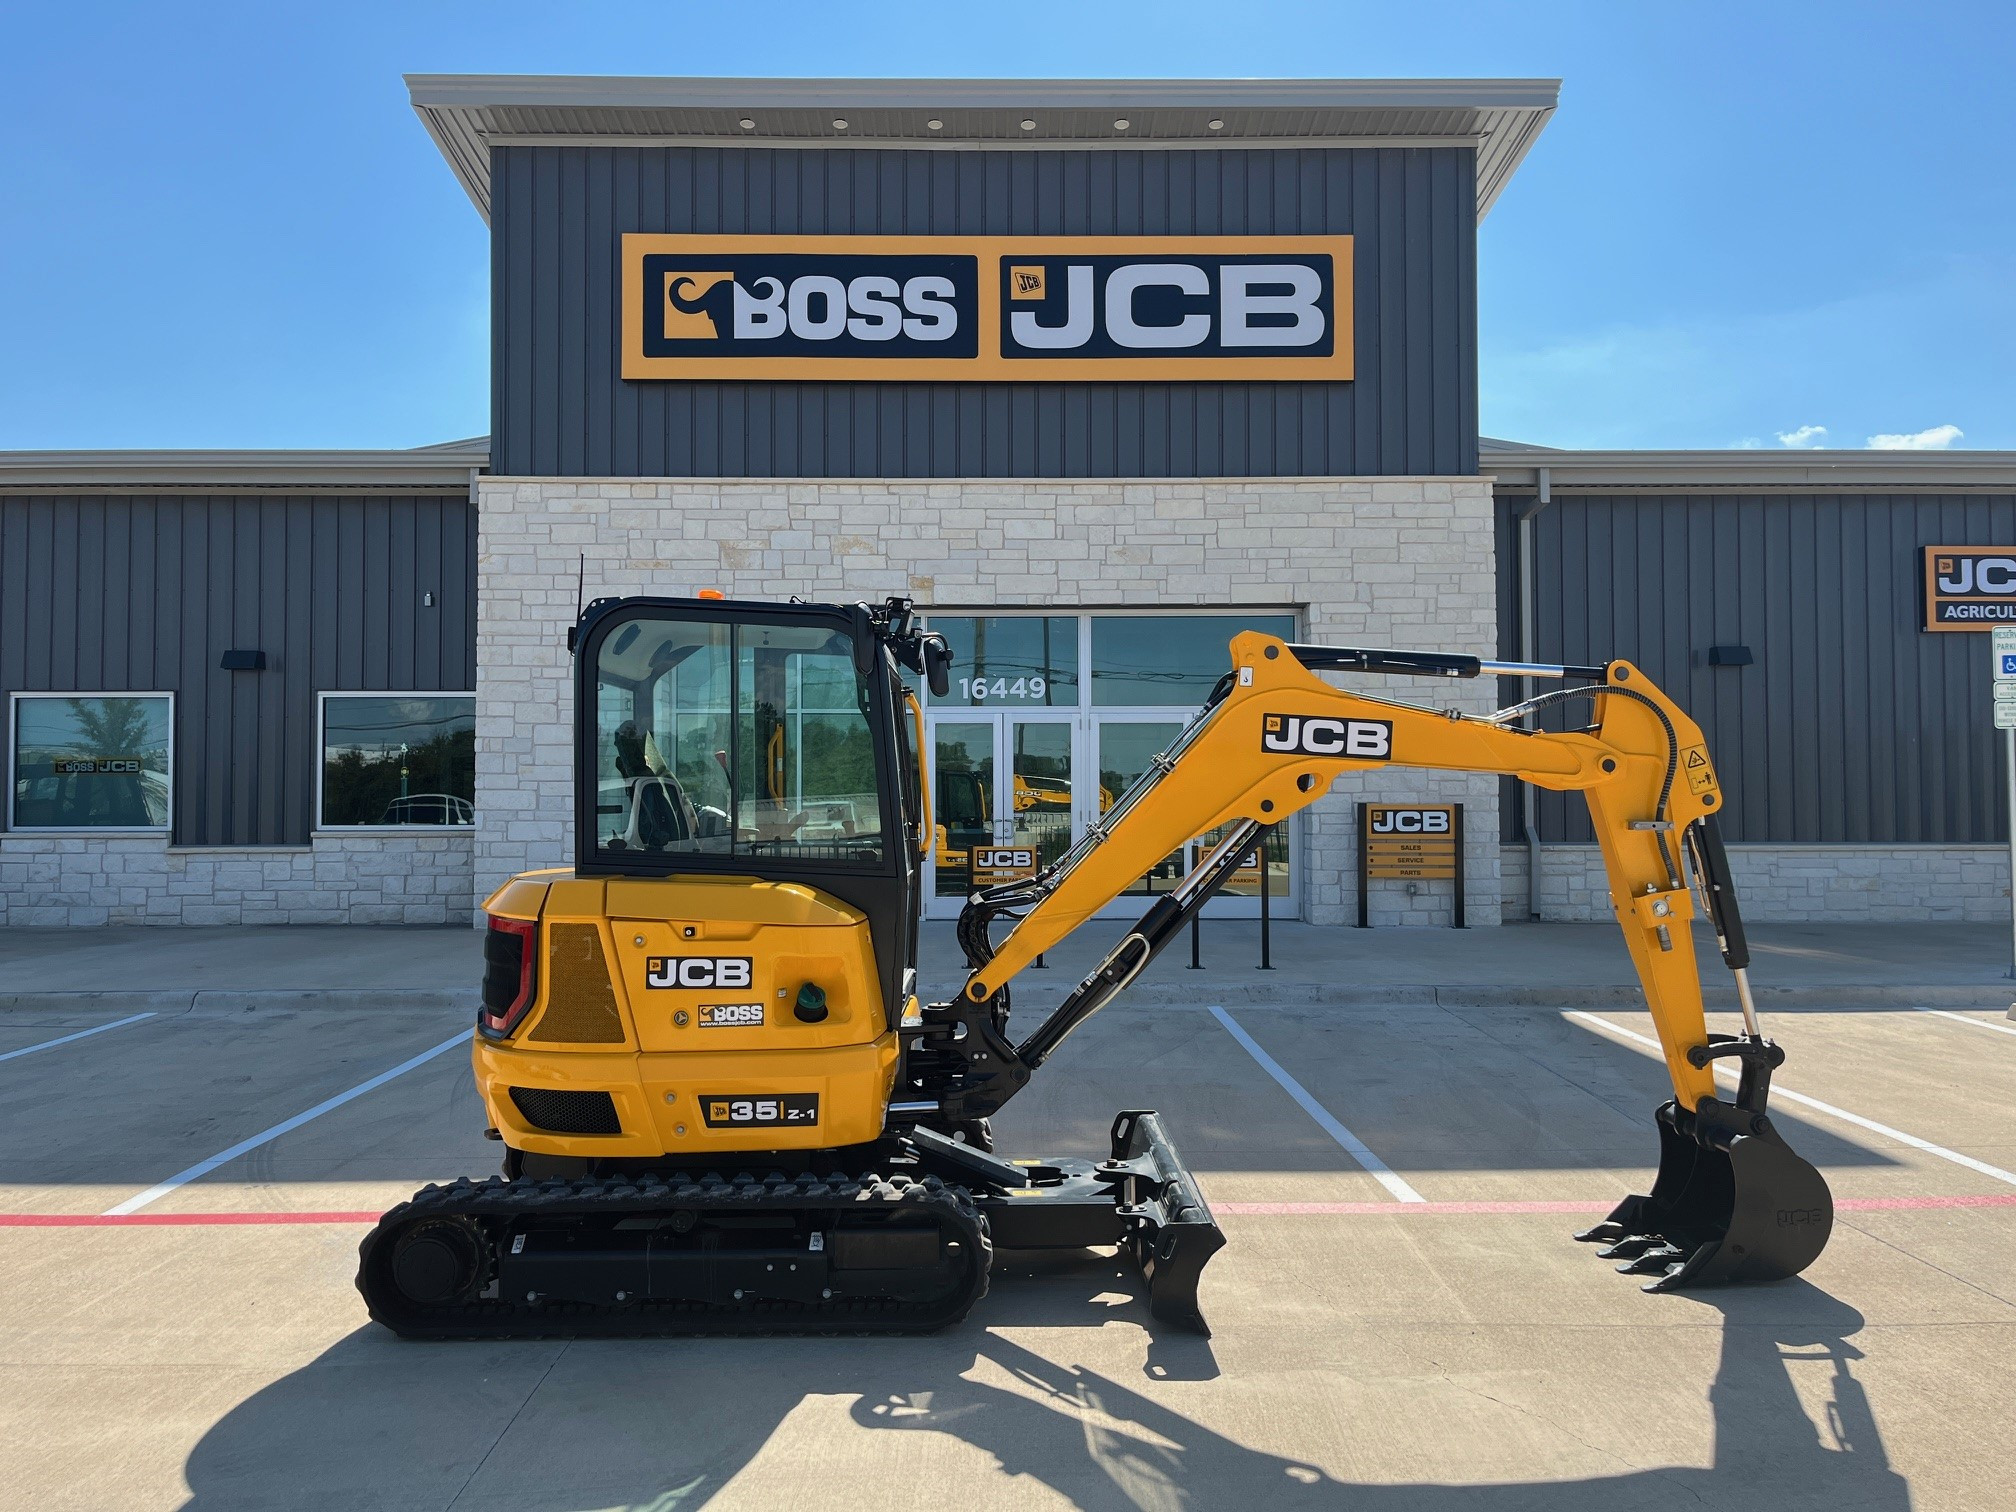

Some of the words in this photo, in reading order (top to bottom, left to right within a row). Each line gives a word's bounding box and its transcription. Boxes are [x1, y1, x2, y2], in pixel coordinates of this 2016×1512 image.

[1019, 274, 1040, 291] JCB
[734, 275, 958, 341] BOSS
[1011, 264, 1326, 349] JCB
[1944, 605, 2016, 619] AGRICUL
[959, 677, 1046, 699] 16449
[1265, 718, 1389, 756] JCB
[66, 762, 95, 772] BOSS
[100, 761, 139, 772] JCB
[1373, 811, 1448, 832] JCB
[978, 851, 1031, 867] JCB
[649, 959, 750, 986] JCB
[714, 1005, 763, 1021] BOSS
[731, 1101, 778, 1121] 35
